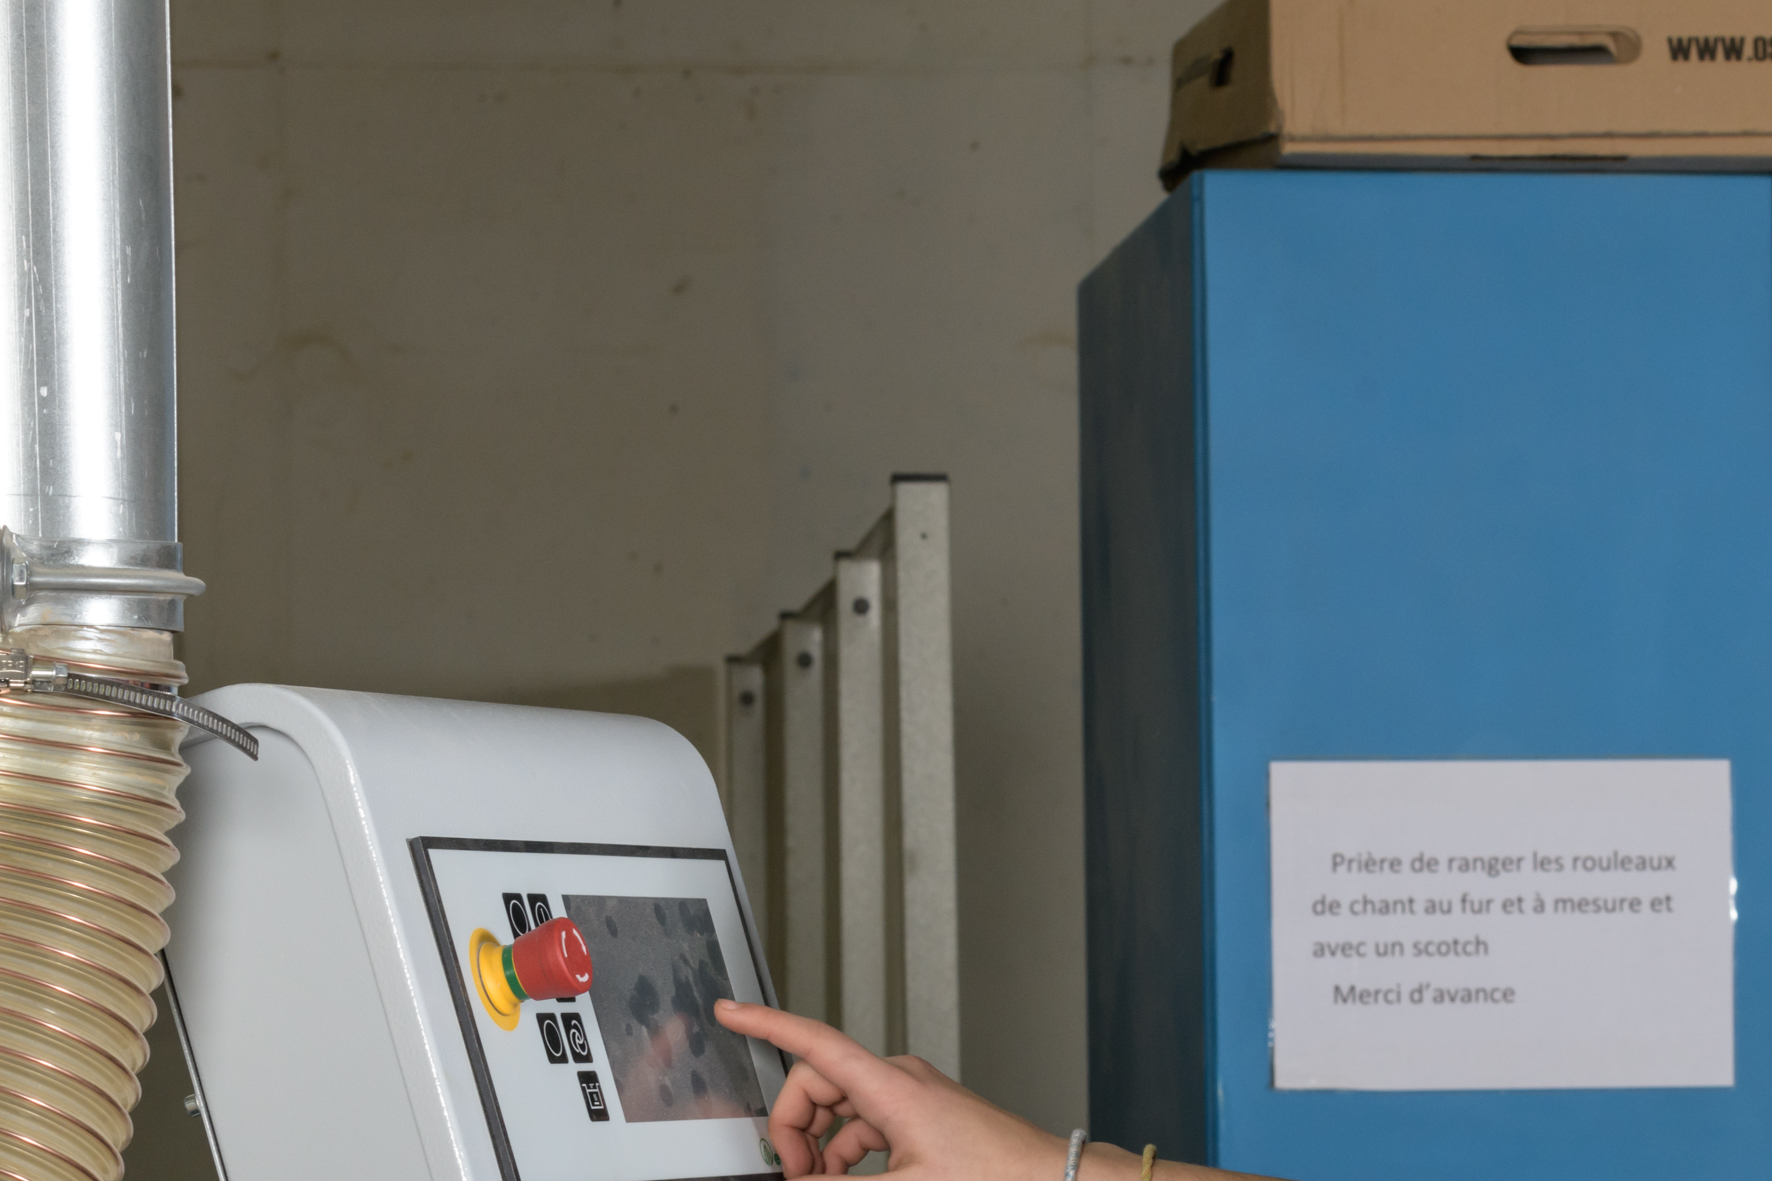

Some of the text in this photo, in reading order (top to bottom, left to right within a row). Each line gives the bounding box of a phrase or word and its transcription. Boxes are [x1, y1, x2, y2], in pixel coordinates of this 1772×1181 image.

[1331, 851, 1676, 878] Prière de ranger les rouleaux
[1312, 892, 1673, 916] de chant au fur et à mesure et
[1313, 936, 1490, 958] avec un scotch
[1333, 984, 1403, 1005] Merci
